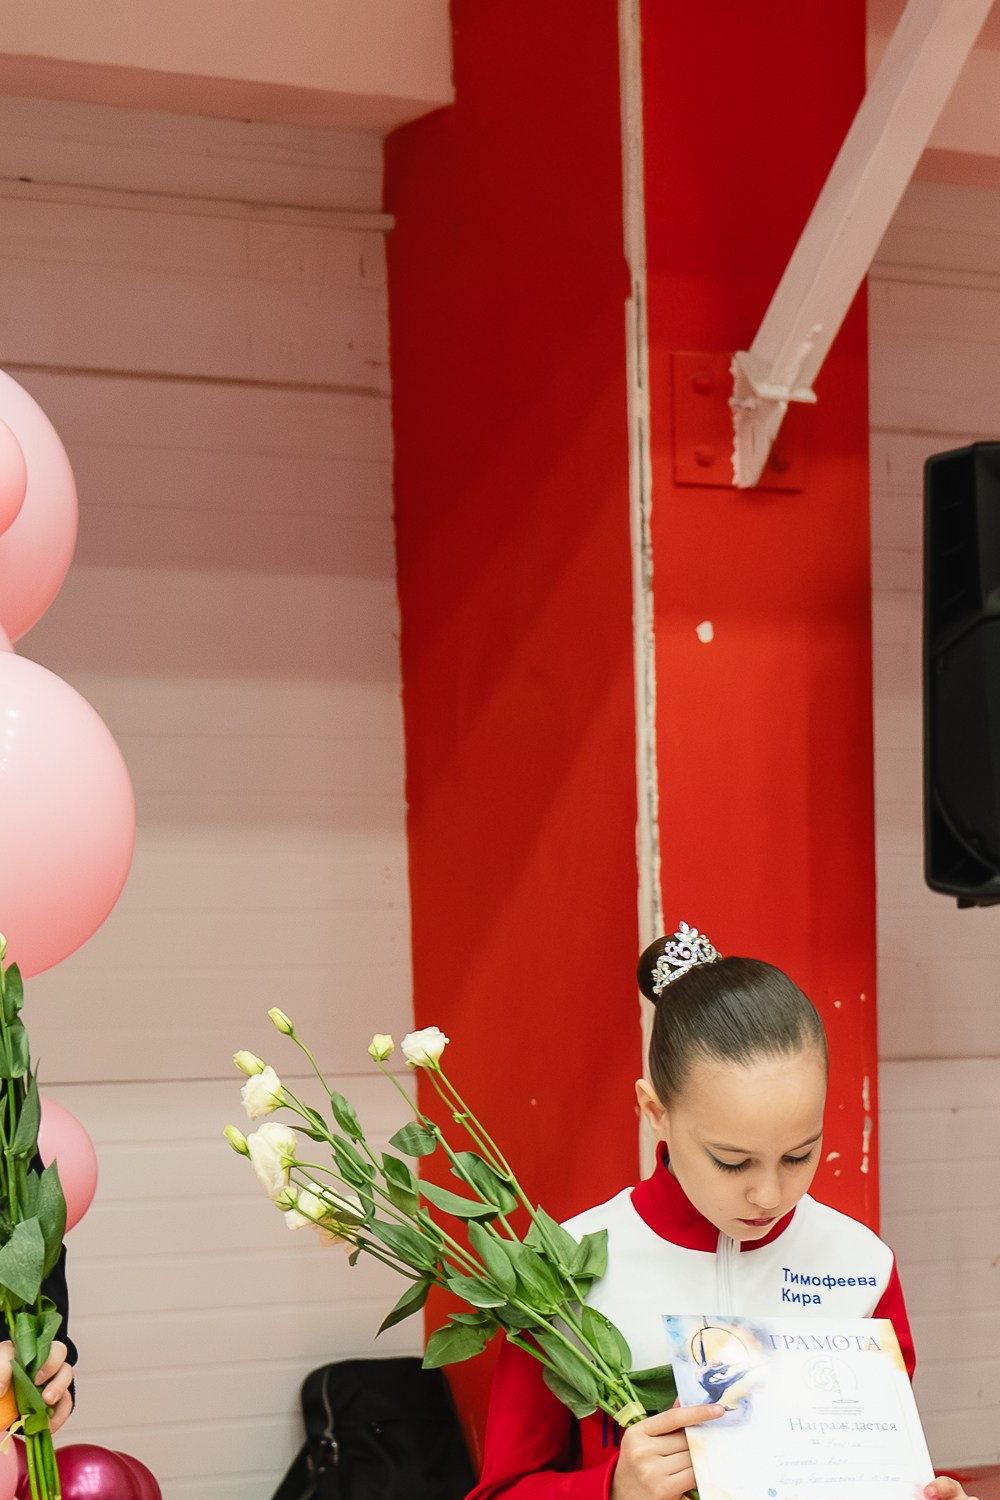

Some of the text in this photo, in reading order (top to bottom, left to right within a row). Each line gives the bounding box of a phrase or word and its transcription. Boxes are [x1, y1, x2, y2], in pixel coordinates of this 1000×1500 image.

[781, 1267, 877, 1290] Тимофеева
[781, 1287, 822, 1307] Кира
[767, 1334, 882, 1351] ГРАМОТА
[787, 1417, 899, 1435] Награждается
